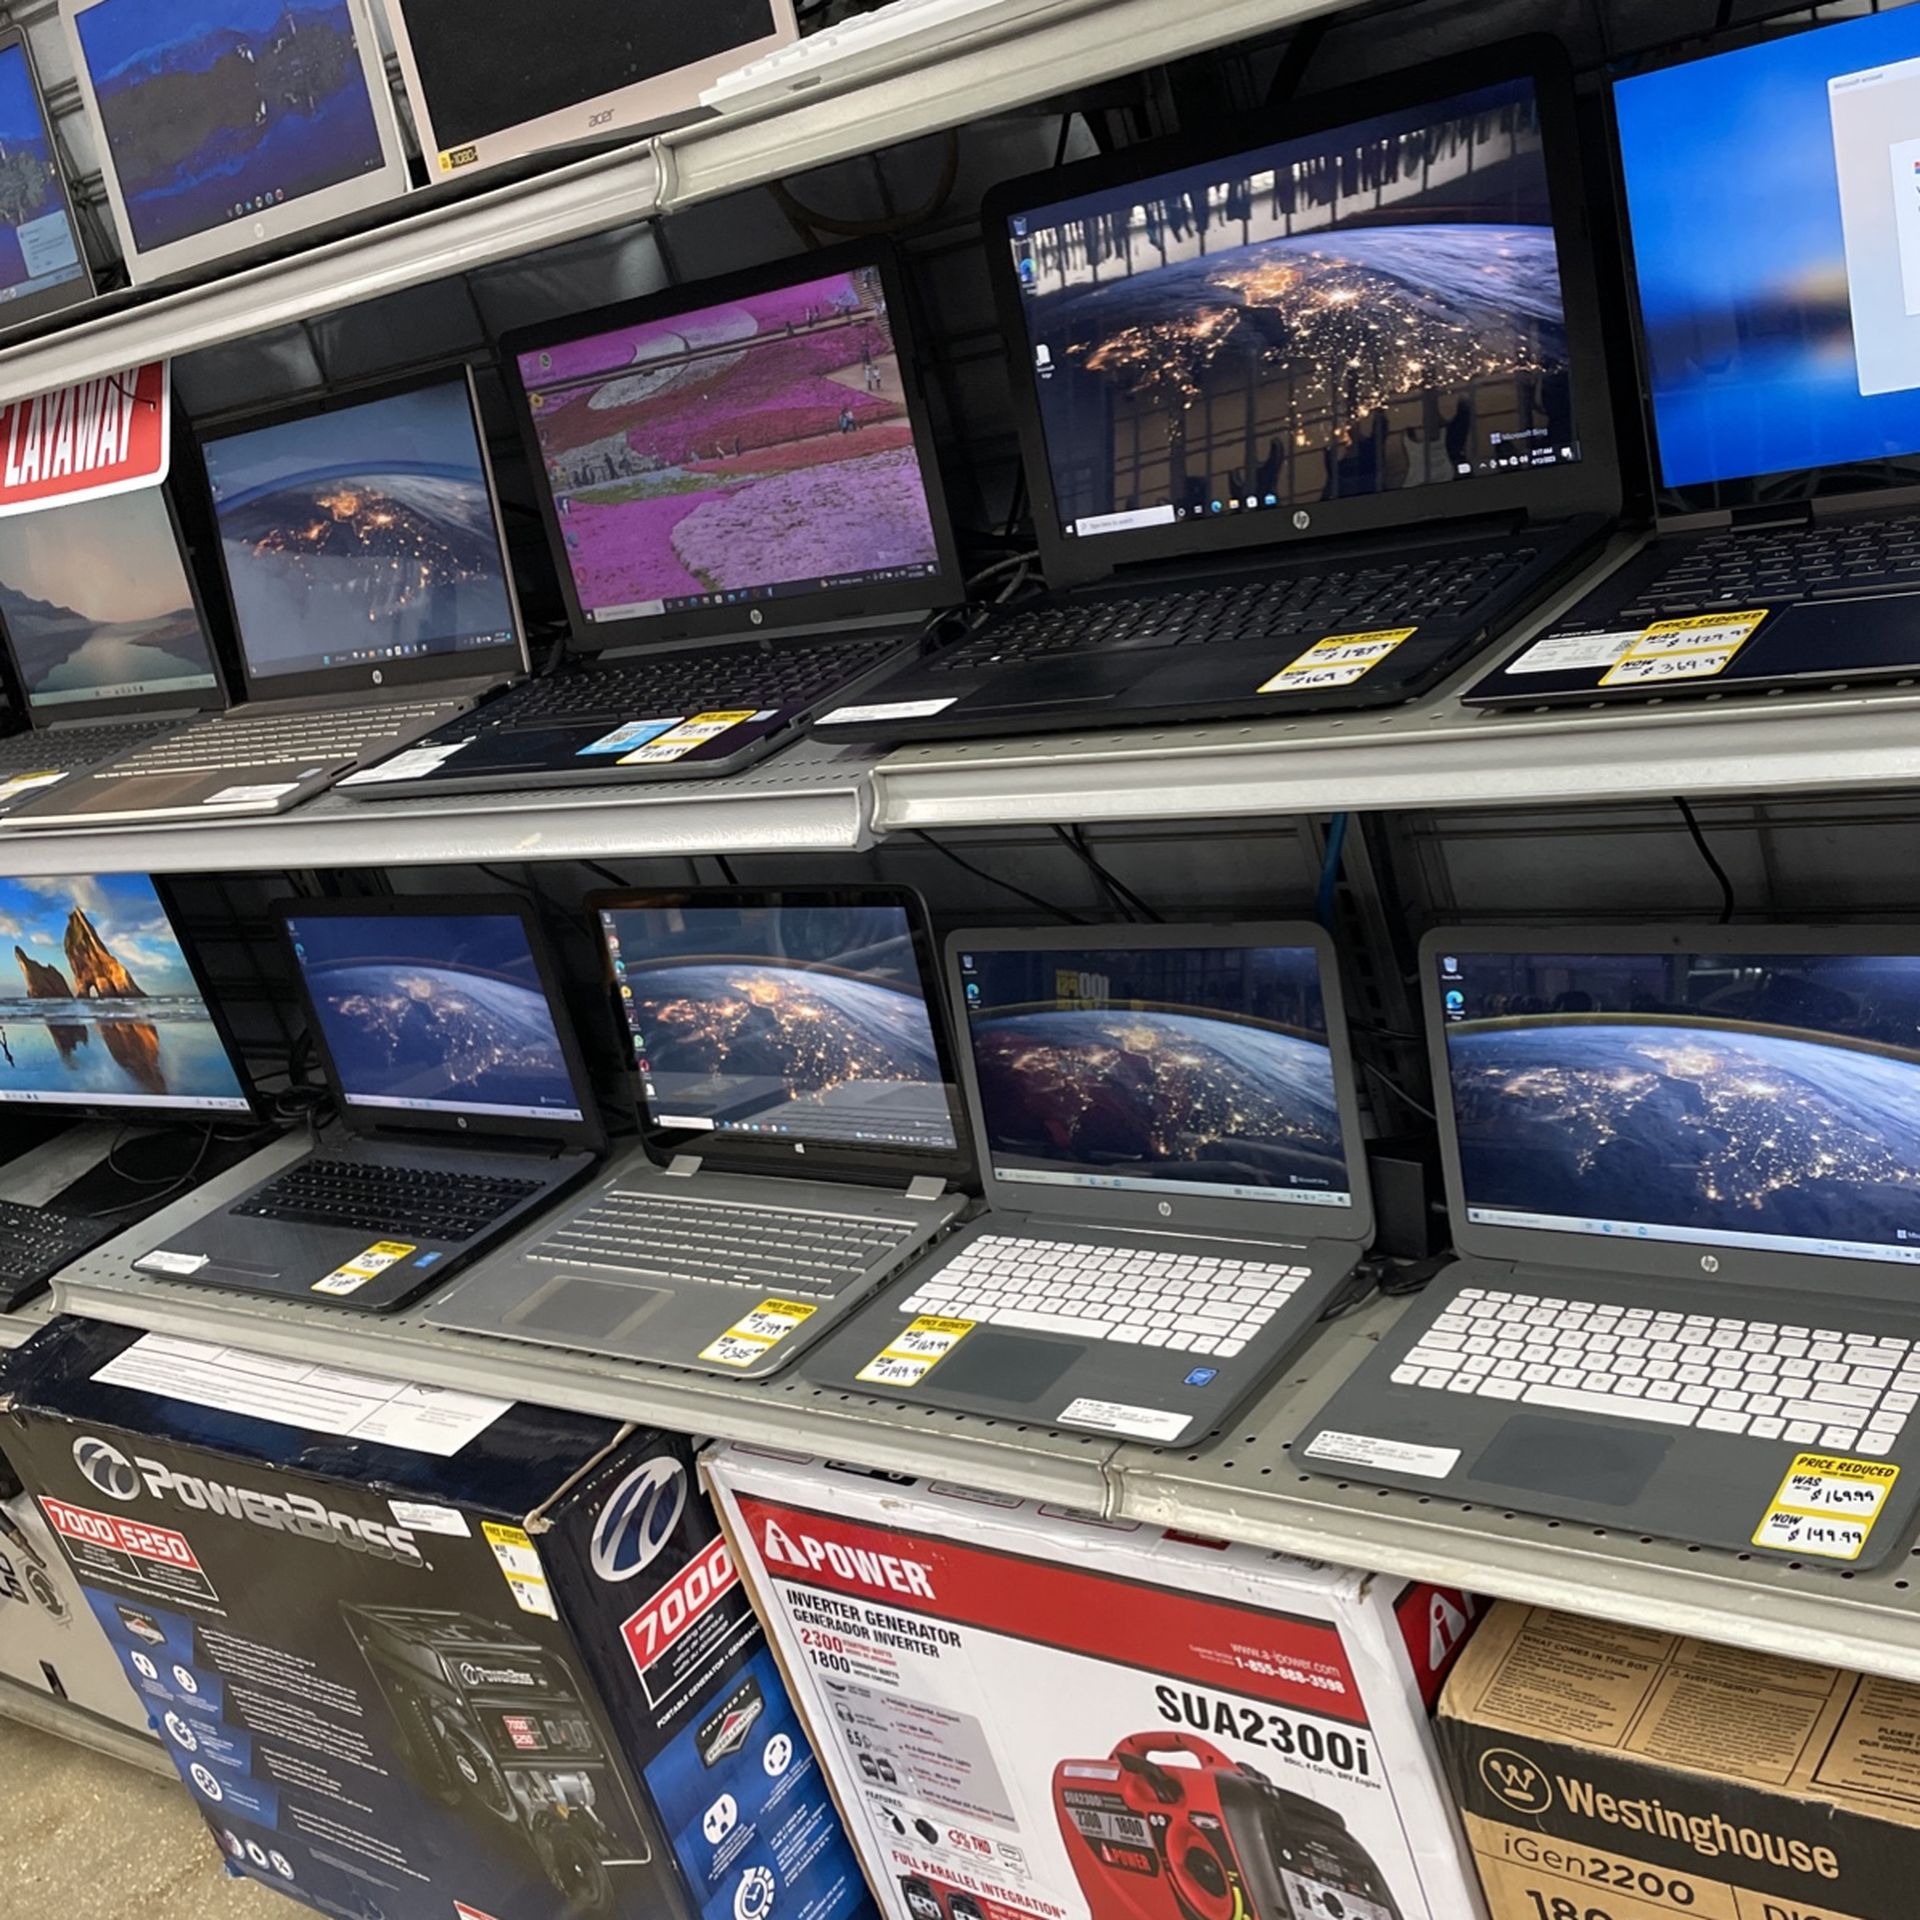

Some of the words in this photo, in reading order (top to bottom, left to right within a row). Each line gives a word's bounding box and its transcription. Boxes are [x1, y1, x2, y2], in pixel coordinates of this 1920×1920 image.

[588, 109, 615, 128] acer
[4, 368, 140, 488] LAYAWAY
[1653, 618, 1693, 630] PRICE
[1699, 611, 1763, 625] REDUCED
[1646, 632, 1680, 642] WAS
[1621, 658, 1657, 668] NOW
[1700, 1254, 1718, 1273] hp
[1797, 1456, 1834, 1470] PRICE
[1836, 1463, 1895, 1478] REDUCED
[1792, 1474, 1822, 1487] WAS
[1810, 1488, 1822, 1502] $
[1825, 1489, 1875, 1504] 169.99
[1770, 1512, 1803, 1525] NOW
[49, 1505, 116, 1545] 7000
[119, 1526, 190, 1564] 5250
[1787, 1527, 1800, 1542] $
[1807, 1527, 1863, 1544] 149.99
[635, 1543, 734, 1657] 7000
[786, 1588, 861, 1622] INVERTER
[864, 1609, 962, 1649] GENERATOR
[792, 1609, 870, 1641] GENERADOR
[873, 1630, 940, 1659] INVERTER
[801, 1628, 844, 1654] 2300
[809, 1649, 851, 1674] 1800
[1522, 1634, 1553, 1647] WHAT
[1554, 1642, 1590, 1657] COMES
[1605, 1653, 1625, 1666] THE
[1626, 1660, 1650, 1672] BOX
[1235, 1656, 1346, 1694] 1-855-888-3598
[656, 1693, 690, 1729] PORTABLE
[688, 1657, 725, 1698] GENERATOR
[1155, 1684, 1369, 1776] SUA2300i
[1355, 1775, 1382, 1790] Engine
[1115, 1817, 1145, 1838] 1800
[1555, 1775, 1840, 1880] Westinghouse
[892, 1850, 920, 1871] FULL
[922, 1860, 980, 1891] PARALLEL
[1503, 1832, 1696, 1907] iGen2200
